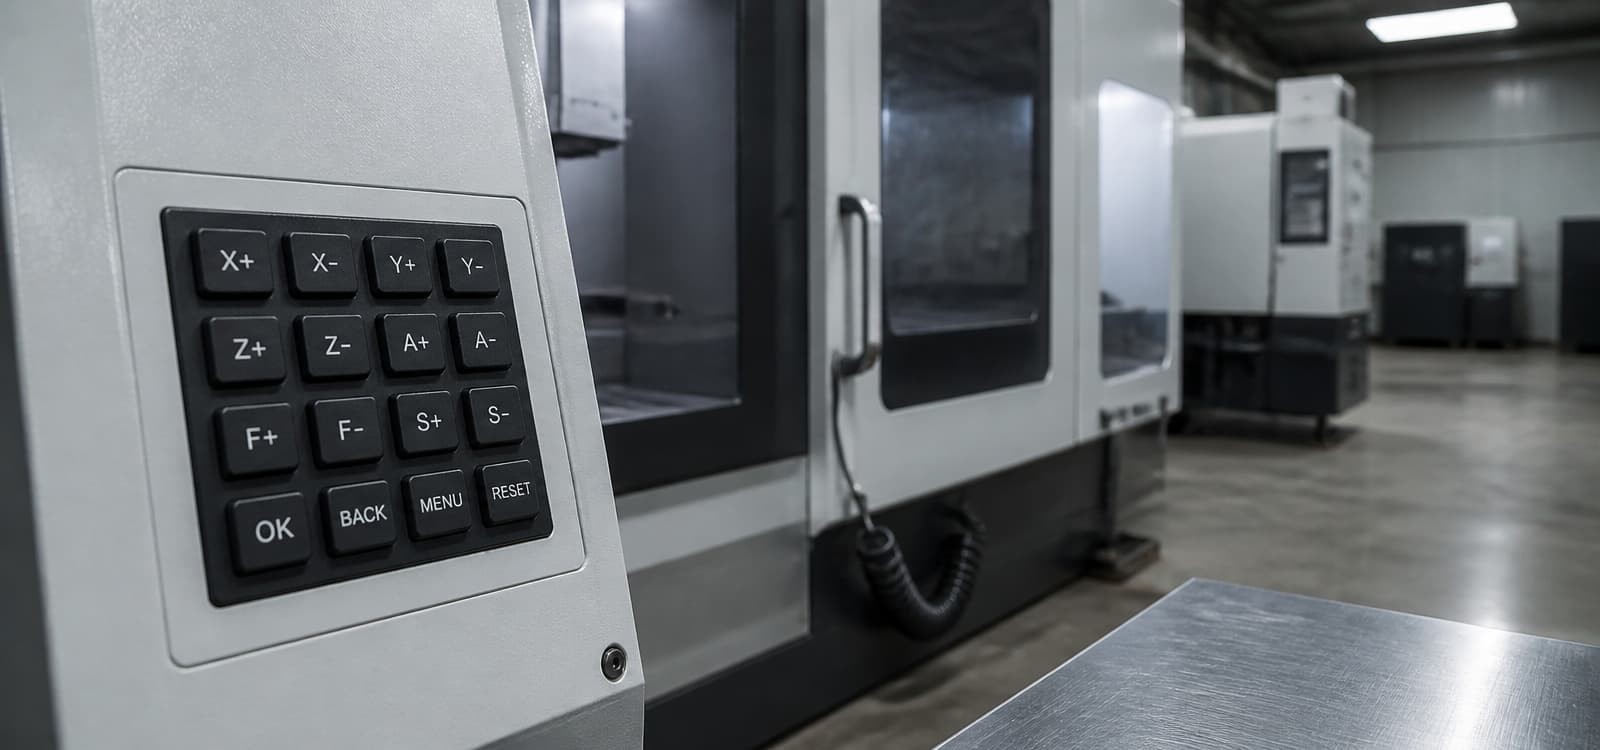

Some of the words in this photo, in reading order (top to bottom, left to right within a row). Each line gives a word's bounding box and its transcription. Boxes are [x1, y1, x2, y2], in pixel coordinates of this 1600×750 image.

[220, 249, 255, 272] X+
[311, 252, 339, 273] X-
[389, 255, 416, 274] Y+
[460, 257, 484, 275] Y-
[233, 338, 267, 360] Z+
[324, 335, 351, 356] Z-
[403, 332, 430, 352] A+
[475, 330, 497, 349] A-
[416, 411, 442, 432] S+
[488, 405, 510, 424] S-
[246, 427, 278, 450] F+
[338, 419, 364, 441] F-
[491, 481, 531, 501] RESET
[419, 492, 463, 513] MENU
[339, 504, 388, 528] BACK
[255, 516, 295, 543] OK
